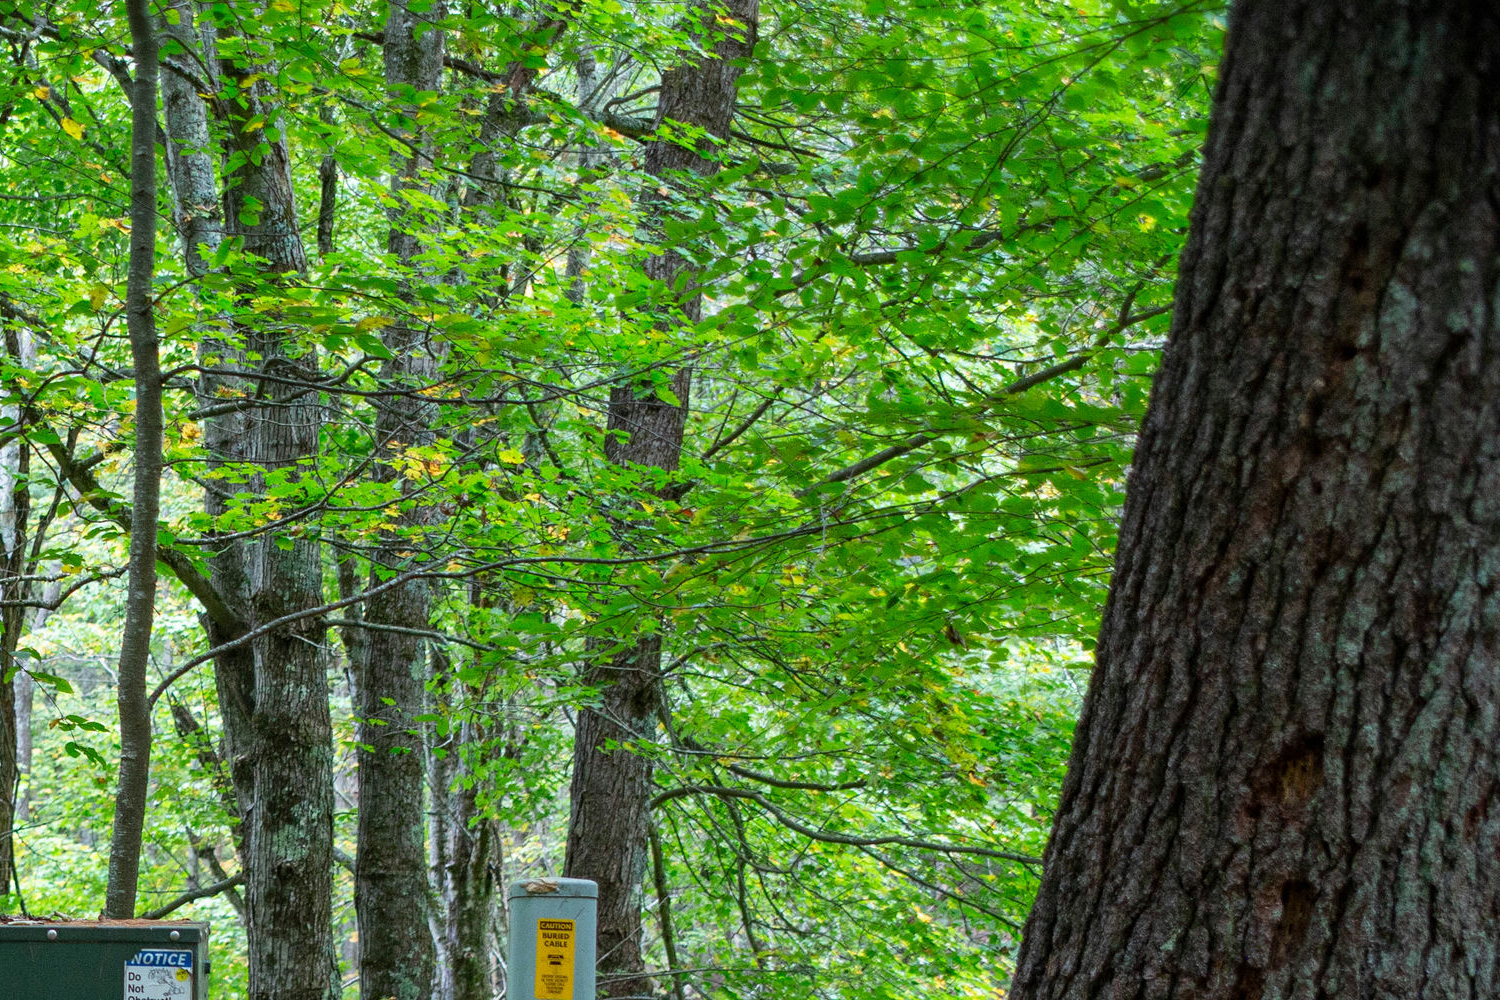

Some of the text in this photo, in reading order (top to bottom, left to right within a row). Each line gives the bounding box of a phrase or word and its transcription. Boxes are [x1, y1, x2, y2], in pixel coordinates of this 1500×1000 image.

[540, 922, 572, 930] CAUTION
[542, 932, 570, 940] BURIED
[544, 940, 568, 948] CABLE
[131, 952, 187, 966] NOTICE
[128, 971, 141, 981] Do
[128, 984, 144, 993] Not
